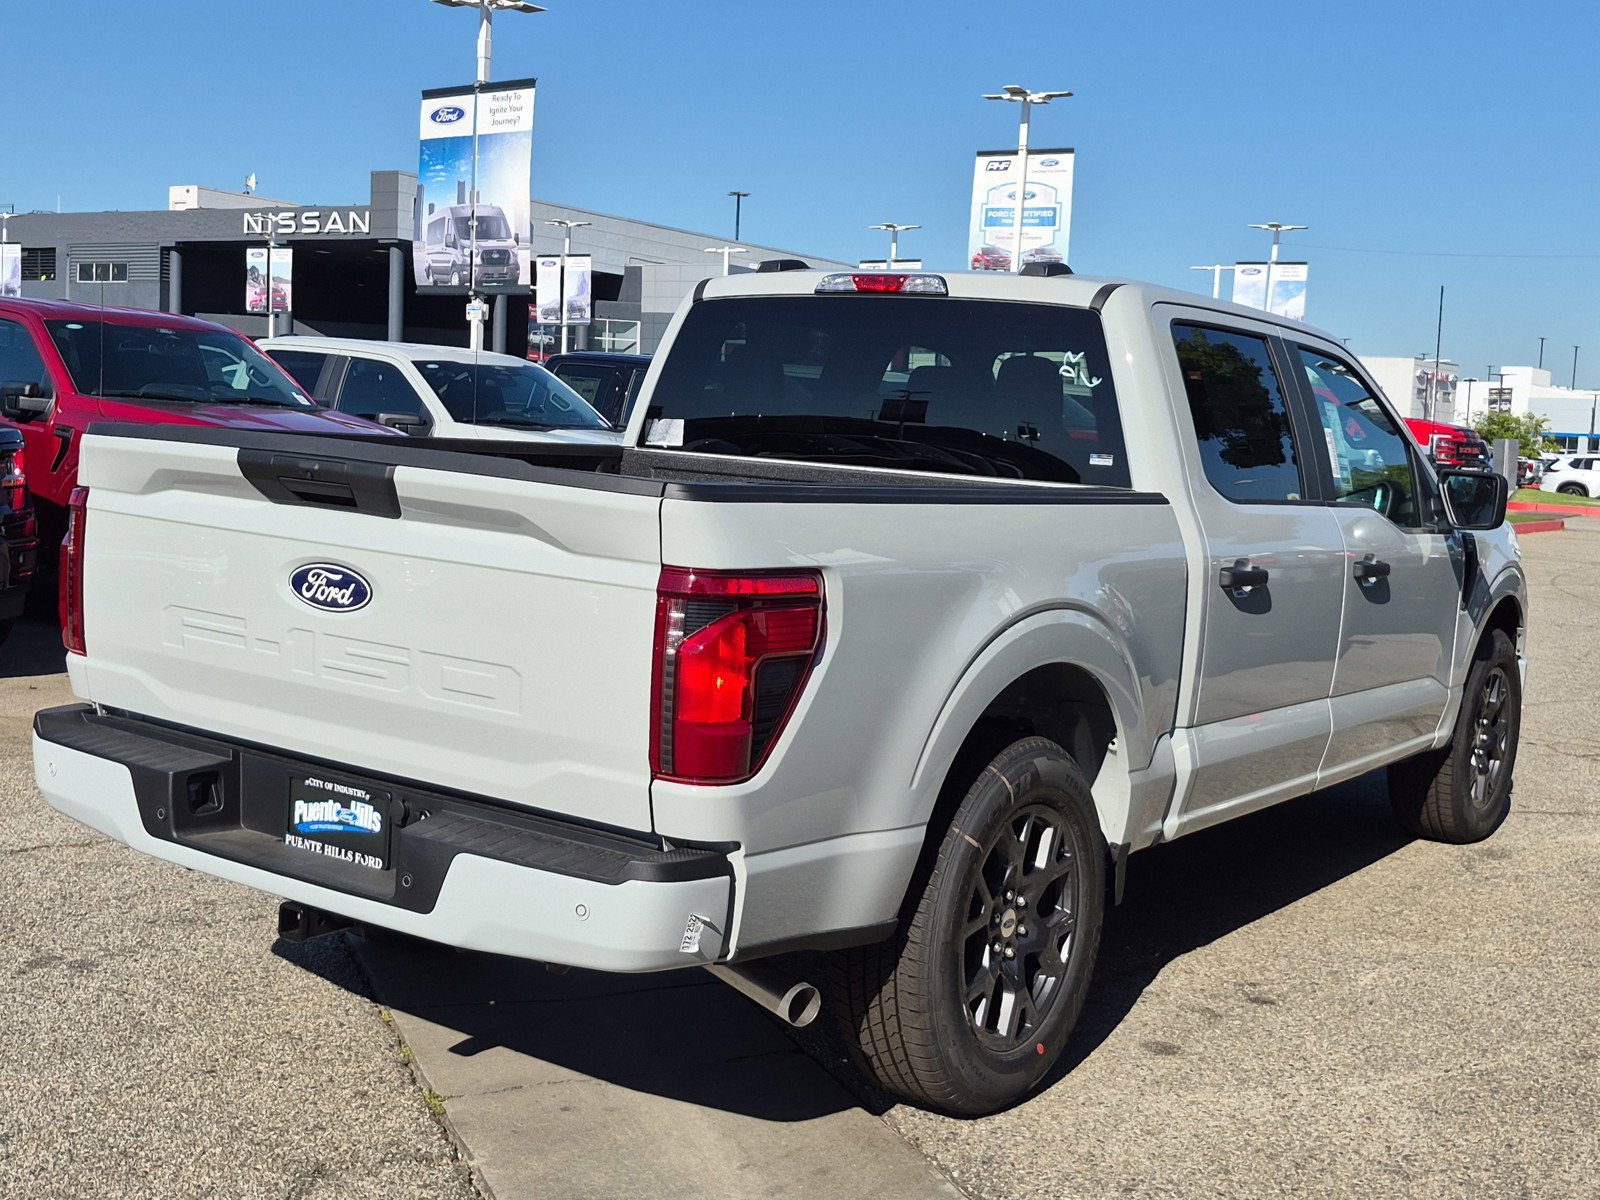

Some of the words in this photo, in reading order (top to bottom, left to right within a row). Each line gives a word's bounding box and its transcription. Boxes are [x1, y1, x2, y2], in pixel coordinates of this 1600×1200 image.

[492, 94, 512, 103] Ready
[513, 92, 522, 100] To
[436, 108, 459, 122] Ford
[489, 106, 508, 116] Ignite
[508, 105, 523, 113] Your
[491, 116, 521, 126] Journey?
[243, 210, 370, 234] NISSAN
[301, 568, 357, 606] Ford
[162, 604, 523, 716] F-150
[308, 777, 324, 788] CITY
[324, 781, 333, 790] OF
[334, 783, 366, 798] INDUSTRY
[294, 799, 342, 824] Puente
[349, 800, 382, 832] Hills
[285, 833, 323, 853] PUENTE
[324, 844, 354, 862] HILLS
[354, 851, 383, 869] FORD
